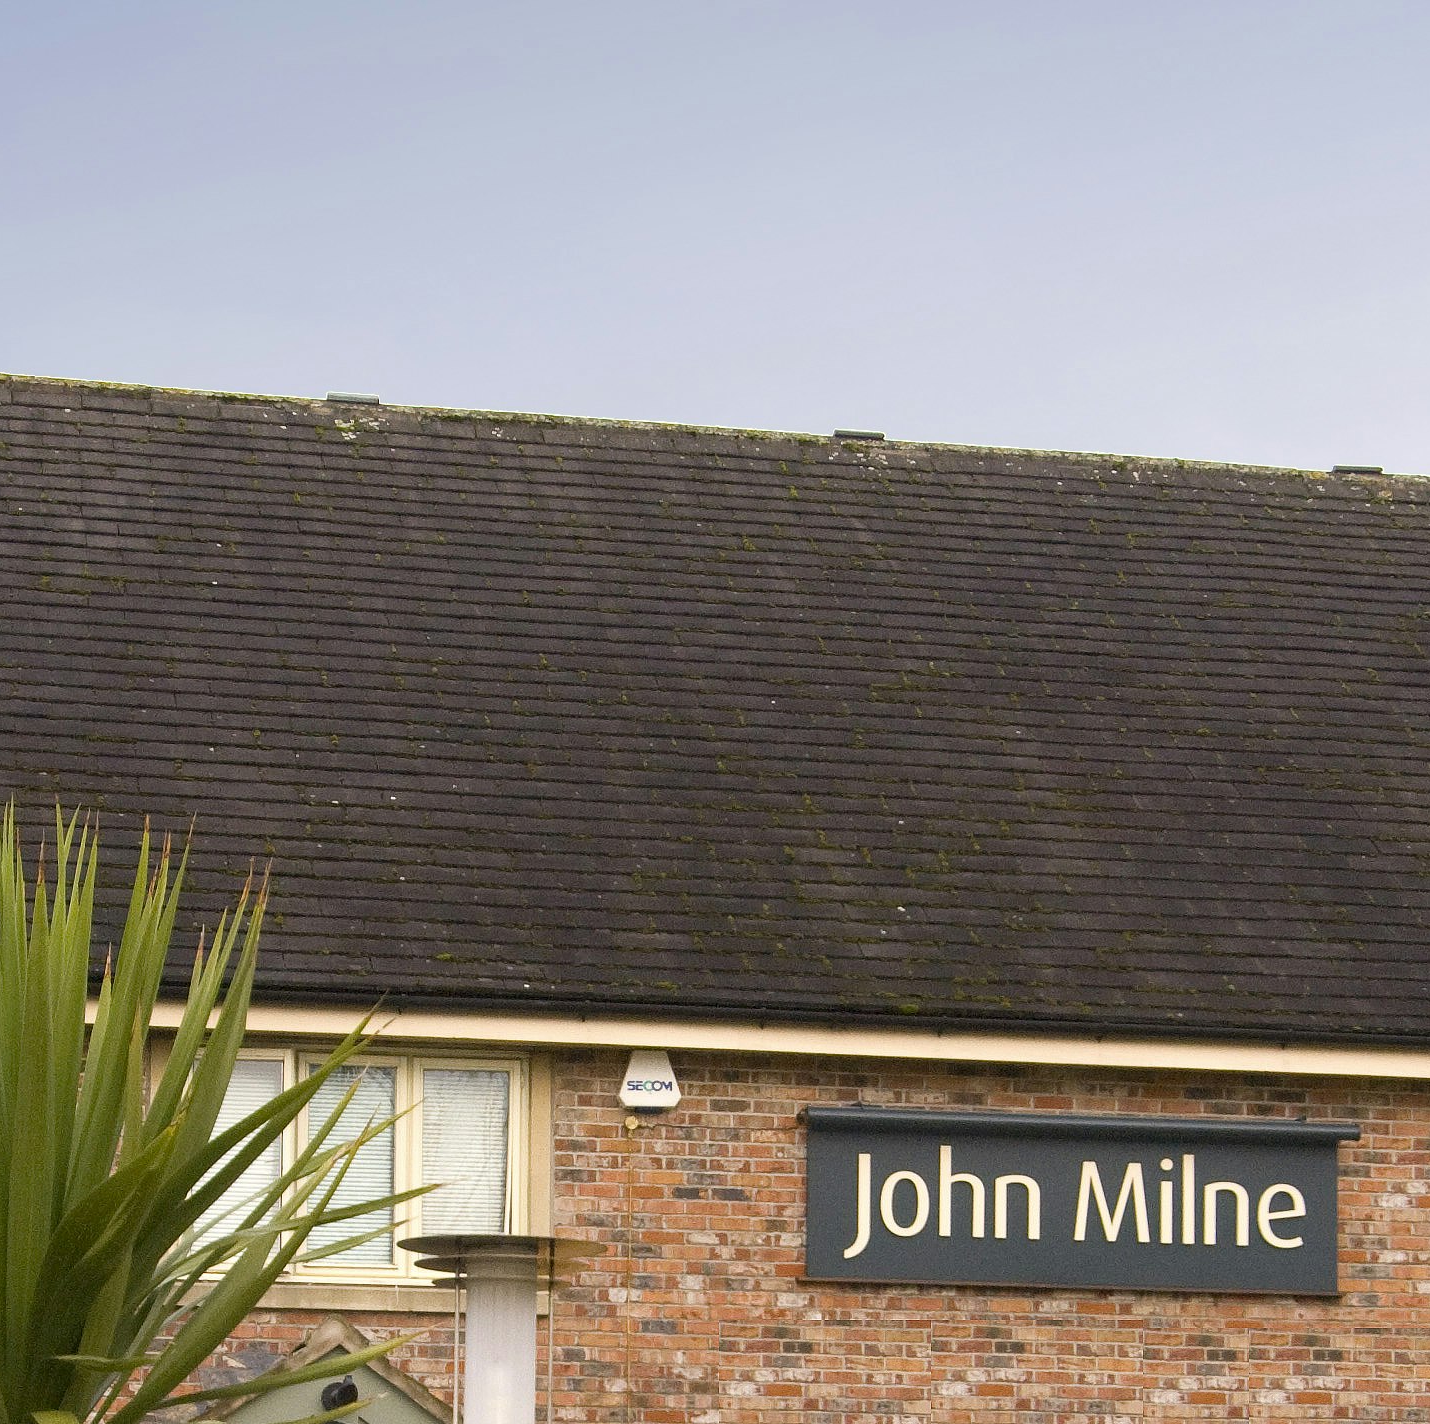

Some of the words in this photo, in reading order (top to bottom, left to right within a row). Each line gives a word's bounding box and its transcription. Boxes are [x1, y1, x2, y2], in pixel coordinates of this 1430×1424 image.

[626, 1080, 673, 1092] SECOM
[843, 1144, 1042, 1260] John
[1073, 1153, 1307, 1250] Milne
